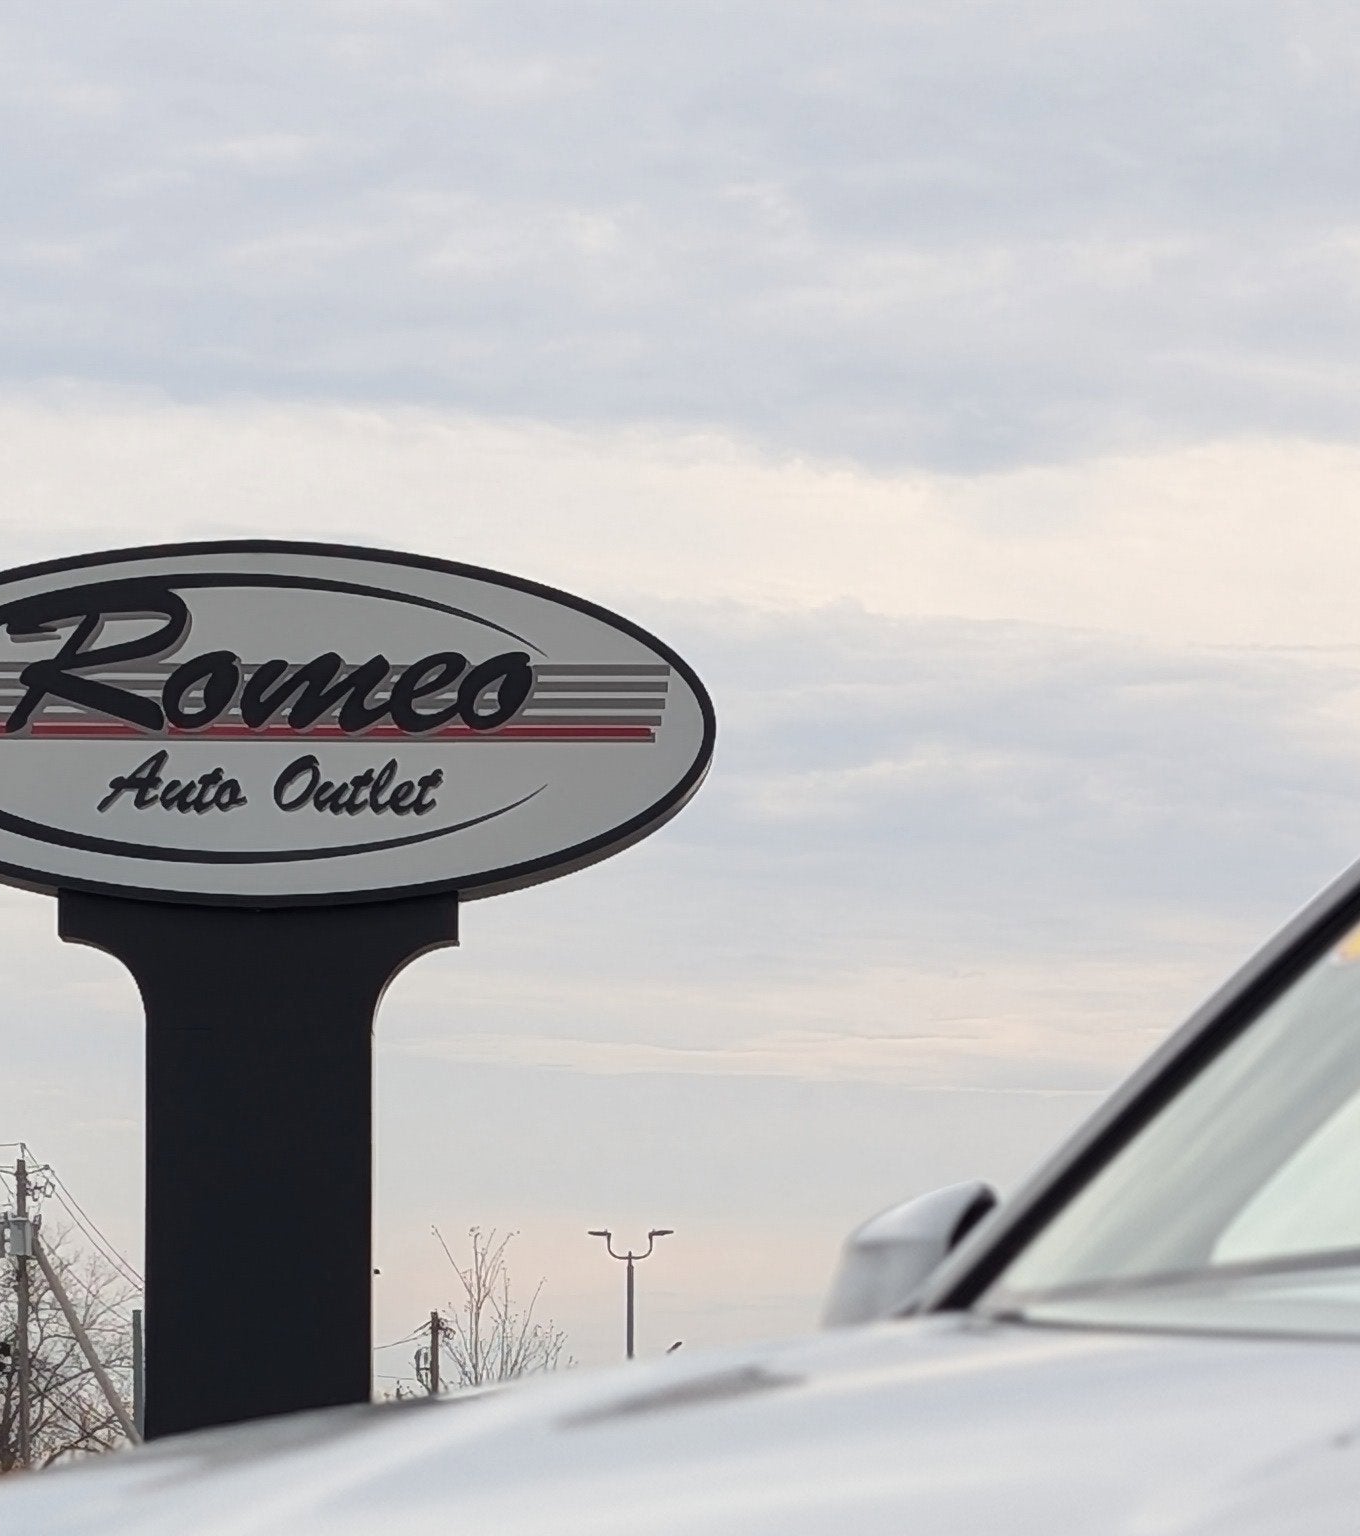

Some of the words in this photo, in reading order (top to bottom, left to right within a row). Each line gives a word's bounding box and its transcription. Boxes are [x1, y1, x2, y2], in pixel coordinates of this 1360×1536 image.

[4, 582, 533, 734] Romeo
[96, 750, 247, 813] Auto
[273, 754, 444, 816] Outlet
